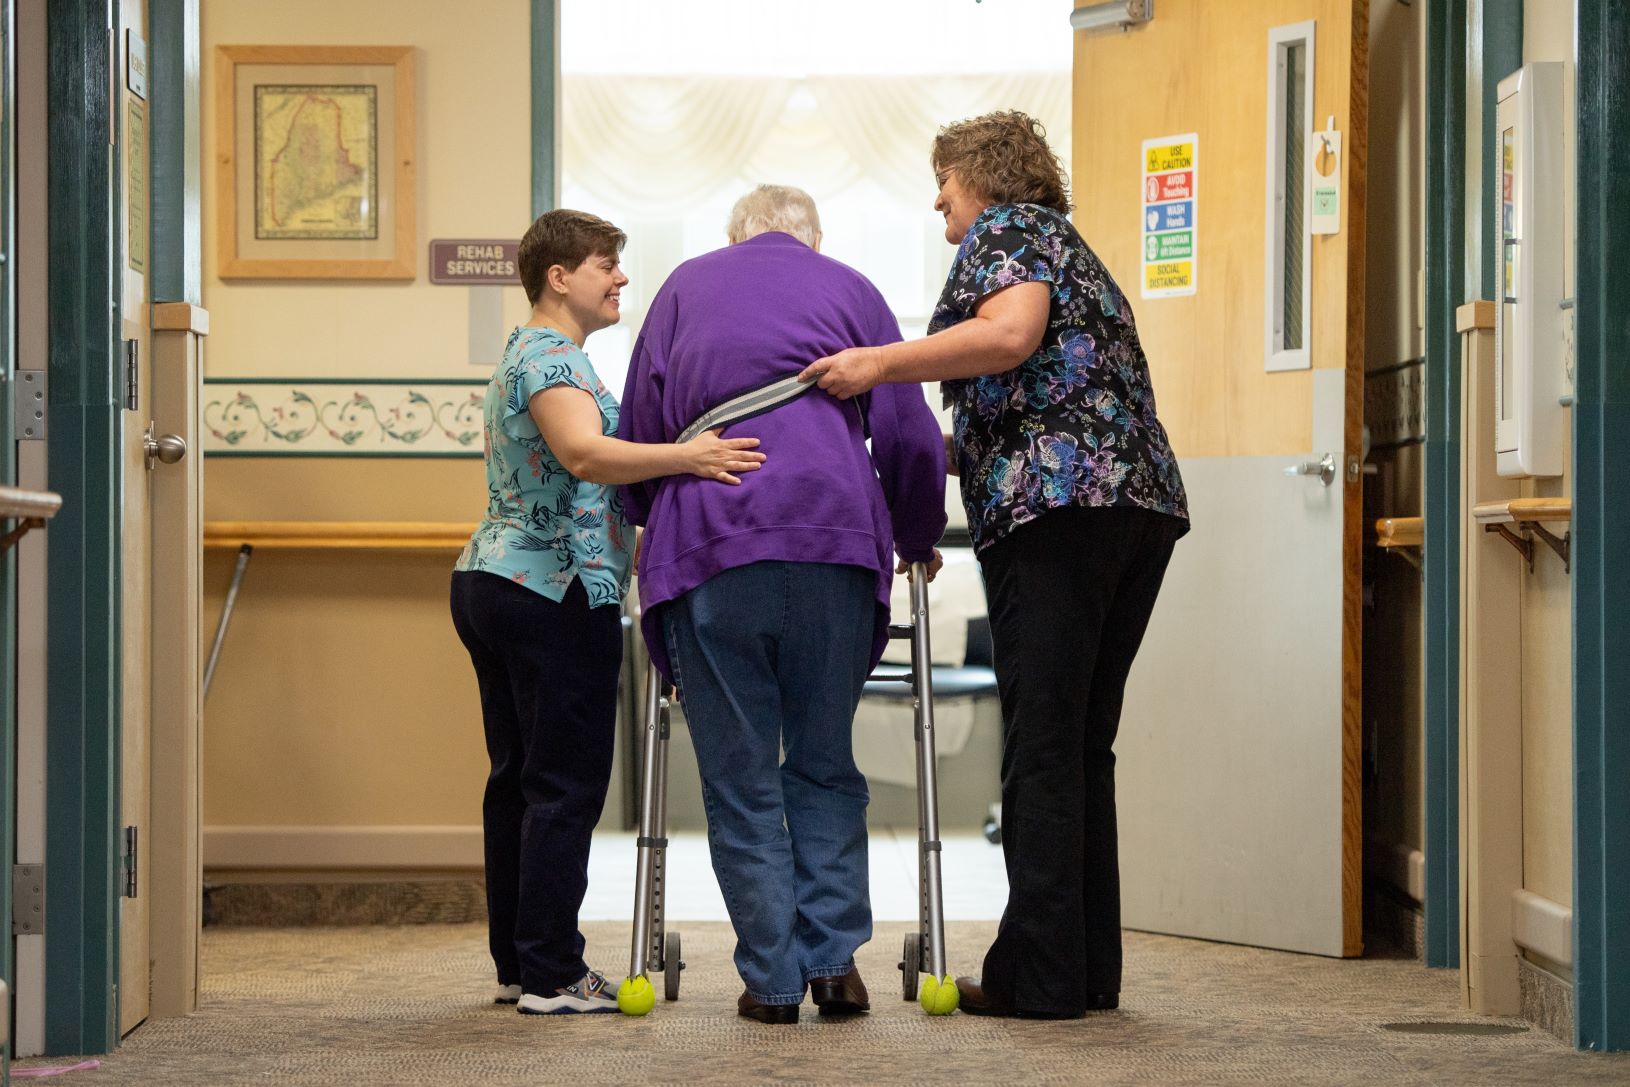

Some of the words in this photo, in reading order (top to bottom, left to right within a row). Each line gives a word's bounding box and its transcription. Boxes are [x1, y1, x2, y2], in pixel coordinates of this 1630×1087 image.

[1170, 145, 1182, 156] USE
[1162, 158, 1191, 170] CAUTION
[1167, 174, 1186, 185] AVOID
[1163, 186, 1190, 198] Touching
[1167, 204, 1185, 216] WASH
[1167, 217, 1185, 228] Hands
[1162, 234, 1190, 246] MAINTAIN
[457, 245, 504, 260] REHAB
[1169, 245, 1191, 256] Distance
[447, 260, 514, 275] SERVICES
[1157, 263, 1180, 275] SOCIAL
[1150, 275, 1188, 288] DISTANCING
